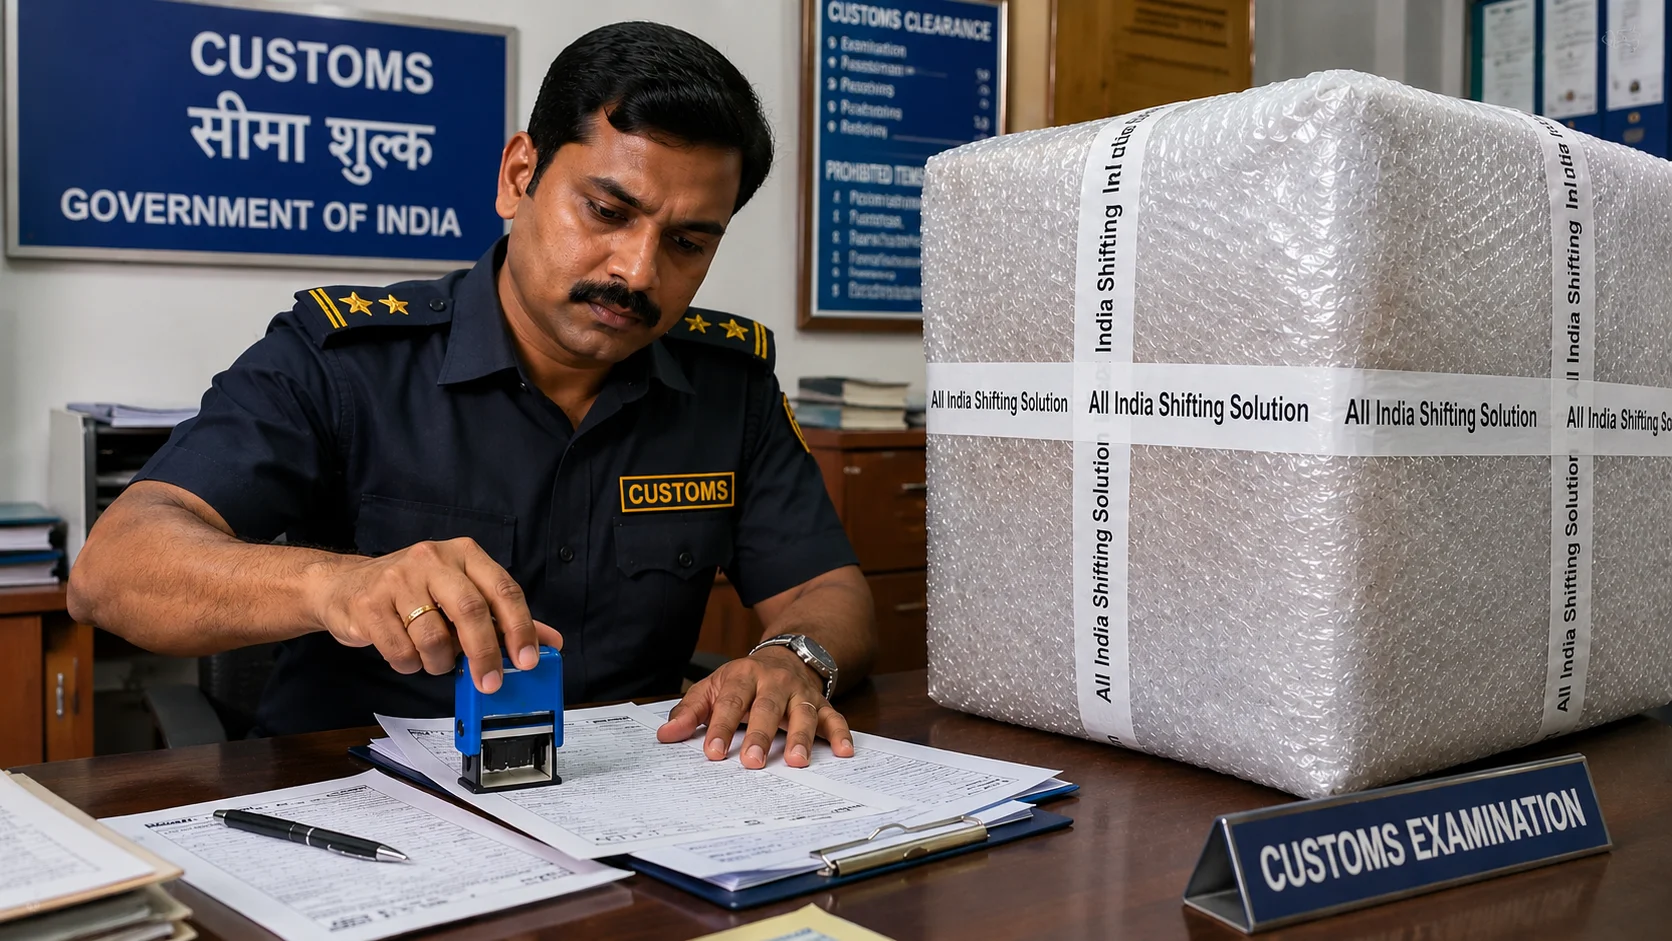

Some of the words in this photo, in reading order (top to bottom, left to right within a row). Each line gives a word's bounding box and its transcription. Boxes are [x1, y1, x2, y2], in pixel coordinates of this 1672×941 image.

[827, 1, 902, 30] CUSTOMS
[904, 11, 992, 41] CLEARANCE
[190, 31, 434, 94] CUSTOMS
[187, 90, 311, 163] सीमा
[325, 116, 436, 185] शुल्क
[826, 160, 893, 185] PROHIBITED
[60, 187, 314, 230] GOVERNMENT
[323, 202, 367, 233] OF
[377, 203, 462, 237] INDIA
[1097, 204, 1123, 292] Shifting
[1567, 220, 1583, 305] Shifting
[1095, 299, 1113, 353] India
[1566, 312, 1580, 363] India
[931, 391, 944, 409] All
[947, 391, 972, 410] India
[974, 391, 1018, 416] Shifting
[1021, 392, 1068, 413] Solution
[1088, 390, 1109, 415] All
[1114, 391, 1154, 416] India
[1158, 391, 1225, 426] Shifting
[1229, 394, 1310, 423] Solution
[1345, 399, 1370, 425] All
[1376, 399, 1415, 426] India
[1419, 401, 1476, 434] Shifting
[1480, 403, 1538, 428] Solution
[1566, 405, 1584, 428] All
[1588, 406, 1617, 429] India
[1620, 409, 1659, 437] Shifting
[629, 480, 728, 504] CUSTOMS
[1093, 529, 1113, 609] Shifting
[1564, 542, 1581, 622] Shifting
[1093, 615, 1110, 668] India
[1560, 628, 1576, 679] India
[1095, 674, 1112, 703] All
[1557, 686, 1571, 713] All
[1260, 822, 1406, 892] CUSTOMS
[1405, 787, 1587, 861] EXAMINATION
